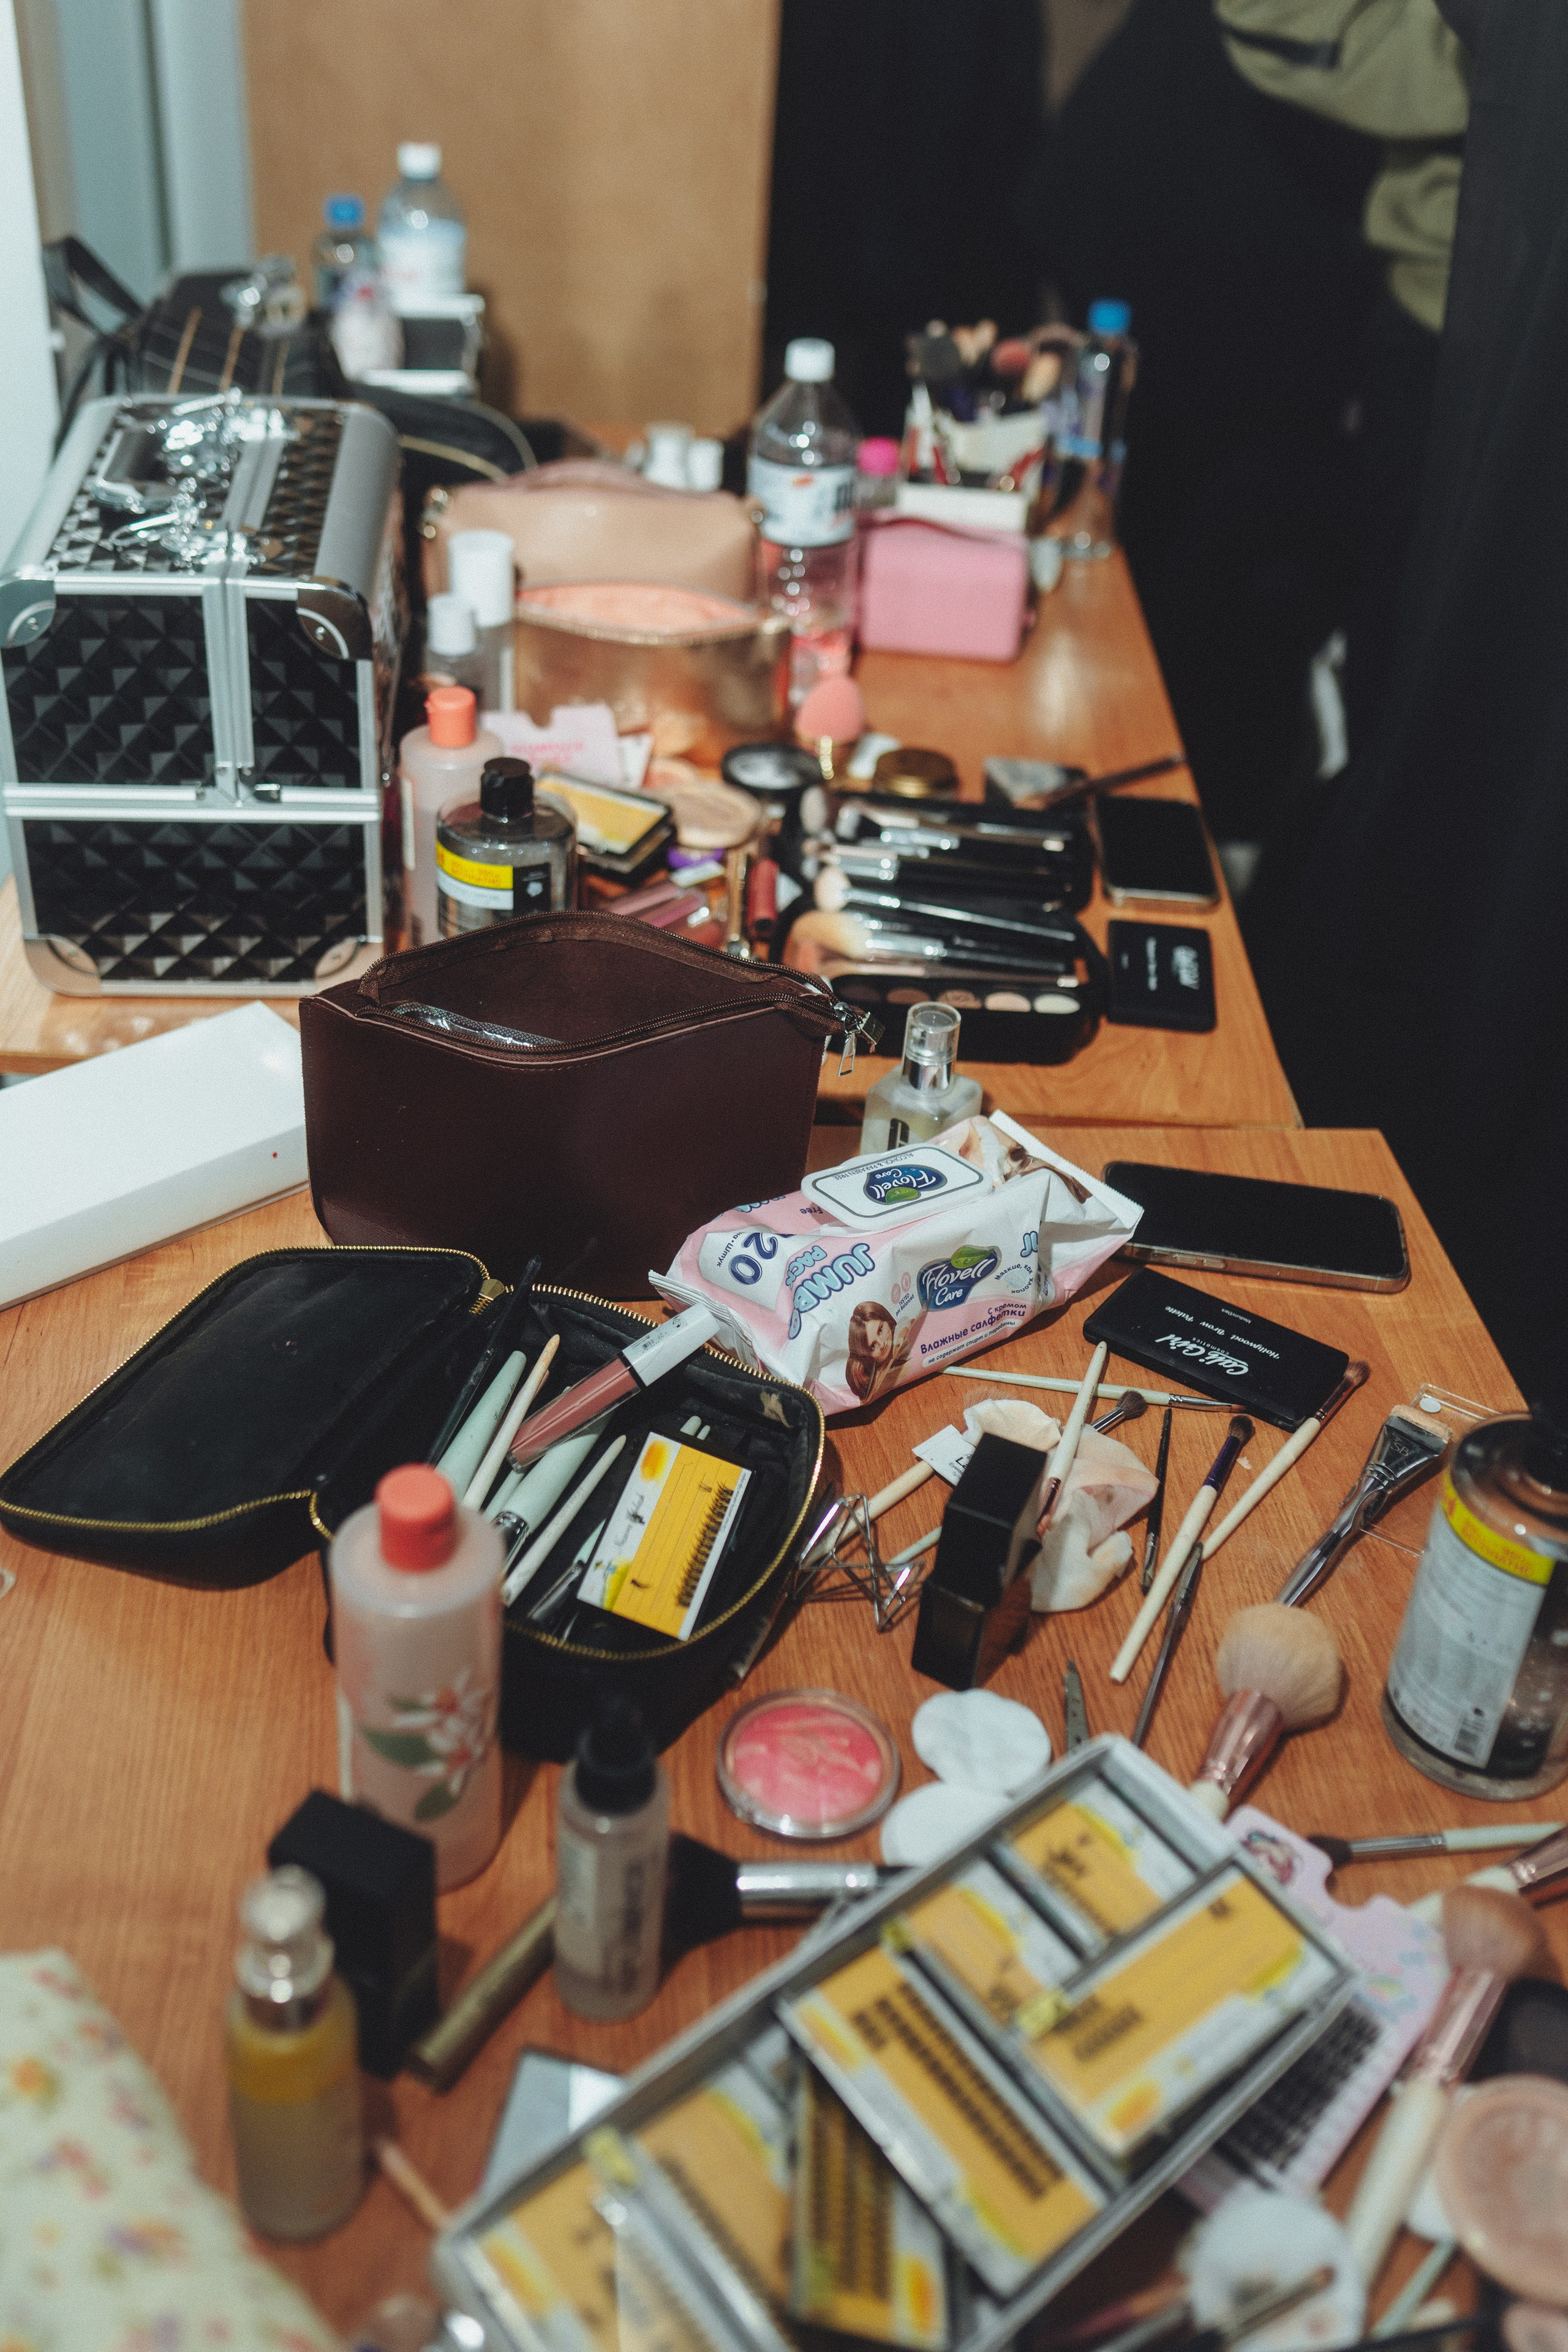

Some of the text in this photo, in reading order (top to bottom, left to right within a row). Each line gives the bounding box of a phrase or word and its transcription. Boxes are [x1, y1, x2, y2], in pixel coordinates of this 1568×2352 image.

[884, 1152, 914, 1167] ALCOHOL
[832, 1170, 850, 1181] FREE
[849, 1163, 878, 1177] PARABEN
[875, 1167, 903, 1179] Care
[869, 1169, 937, 1199] Flovell
[728, 1232, 797, 1286] 20
[922, 1258, 995, 1292] Flovell
[899, 1293, 910, 1306] TESTED
[935, 1286, 963, 1306] Care
[994, 1303, 1027, 1314] кремом
[920, 1310, 1026, 1354] Влажные салфетки
[1165, 1306, 1280, 1359] Hollywood Brow Palette
[936, 1343, 965, 1360] содержат
[966, 1336, 984, 1348] спирт
[1192, 1337, 1229, 1355] cosmetics
[1390, 1442, 1409, 1457] SB
